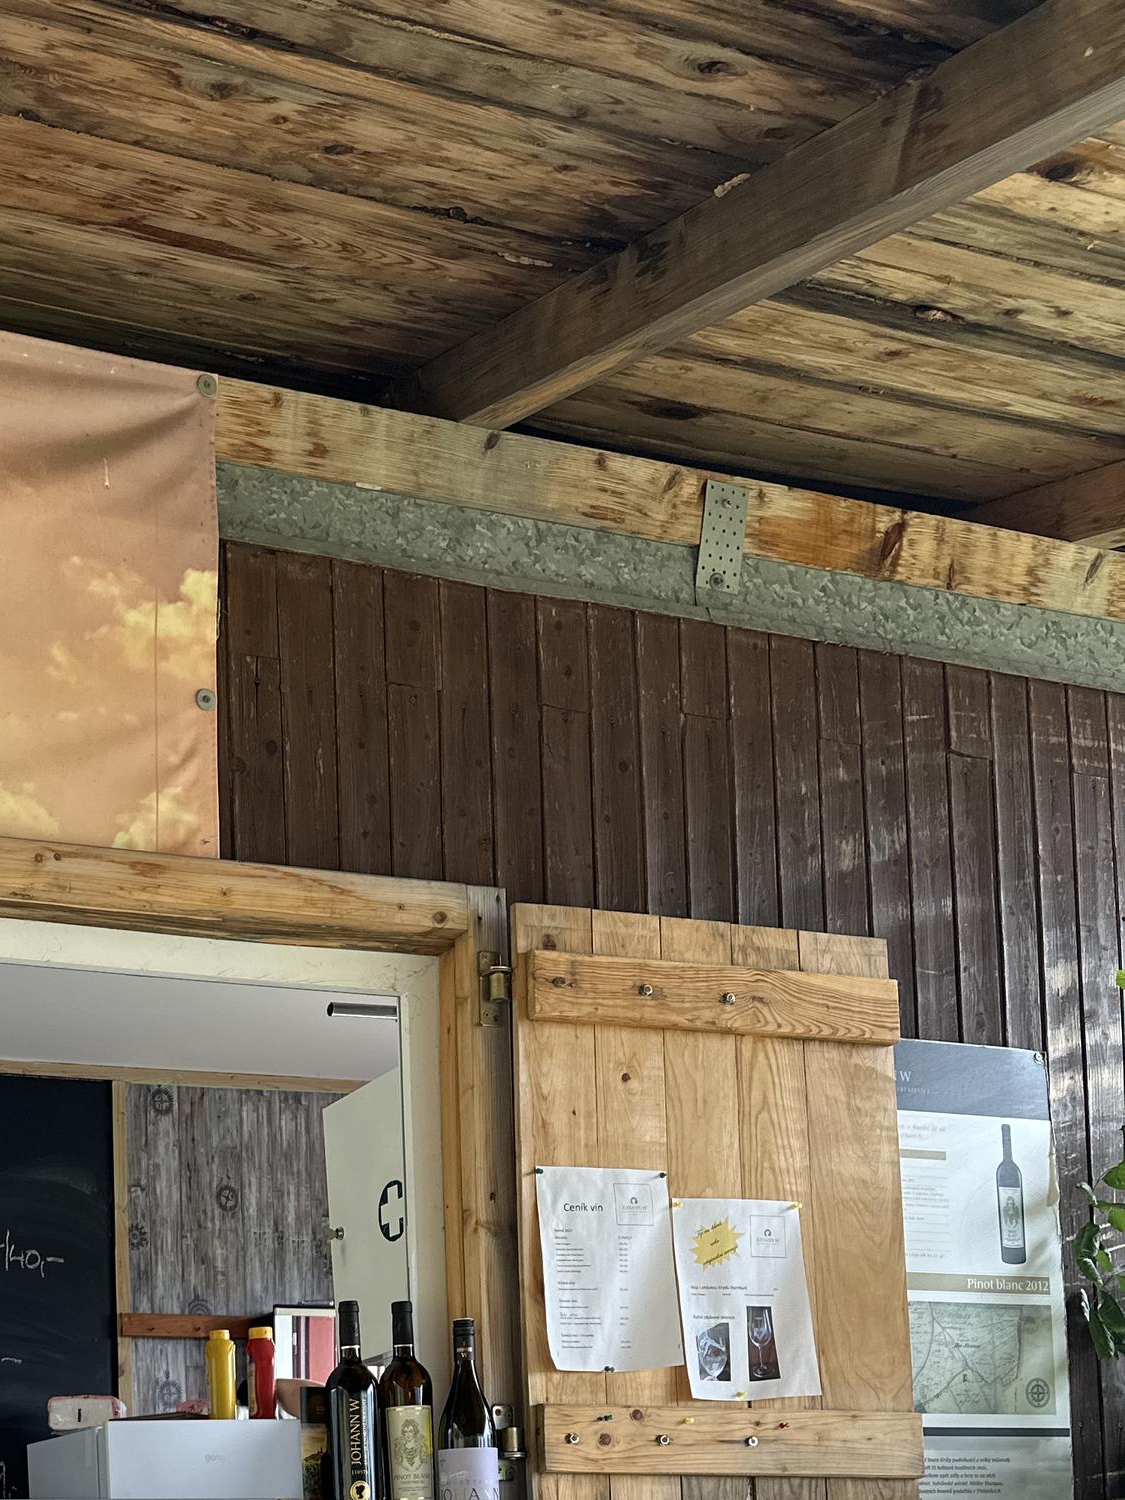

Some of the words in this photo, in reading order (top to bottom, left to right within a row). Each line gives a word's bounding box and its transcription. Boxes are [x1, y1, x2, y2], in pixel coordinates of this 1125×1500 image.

[900, 1070, 912, 1082] W
[563, 1202, 589, 1212] Ceník
[590, 1203, 604, 1212] vín
[967, 1278, 994, 1291] Pinot
[995, 1278, 1025, 1292] blanc
[1025, 1280, 1049, 1293] 2012
[349, 1398, 361, 1413] W
[349, 1414, 362, 1466] JOHANN
